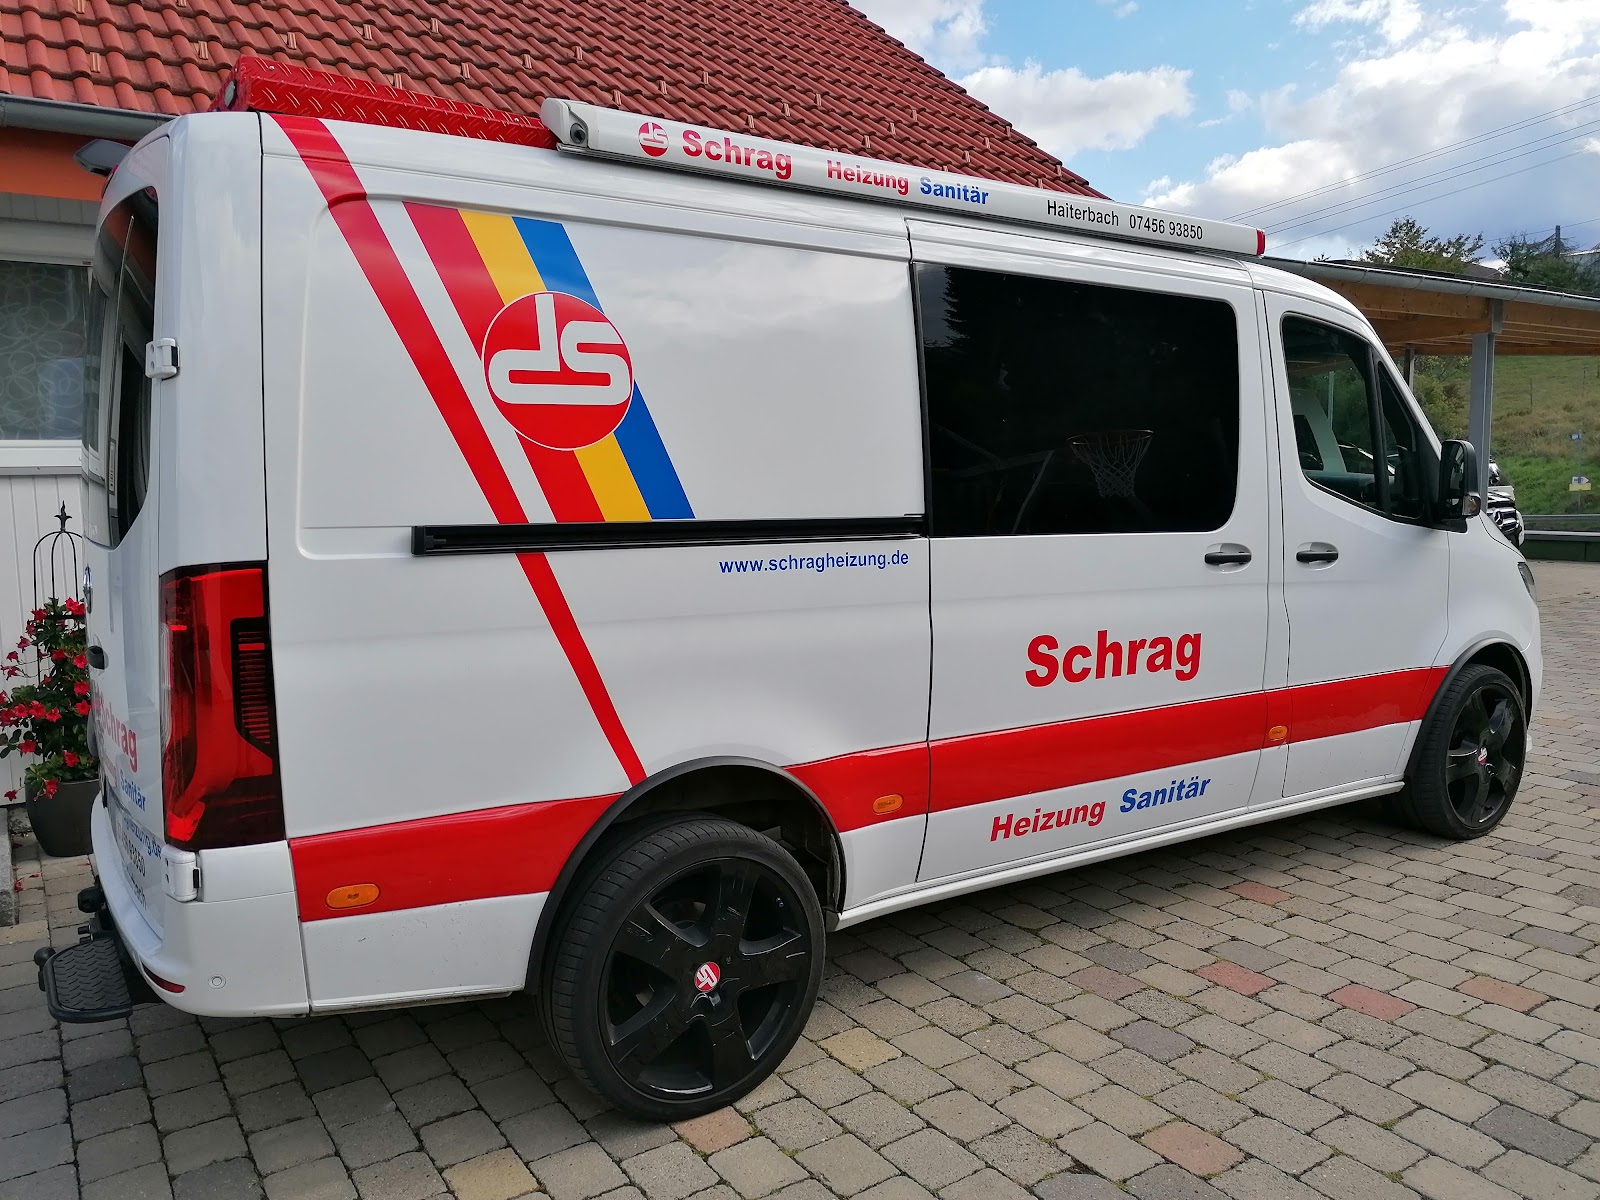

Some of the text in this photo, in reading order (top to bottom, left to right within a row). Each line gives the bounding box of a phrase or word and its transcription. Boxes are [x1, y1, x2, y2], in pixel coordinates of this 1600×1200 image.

[682, 129, 792, 180] Schrag
[826, 159, 909, 196] Heizung
[919, 176, 989, 205] Sanitär
[1046, 199, 1119, 227] Haiterbach
[1129, 214, 1165, 234] 07456
[1168, 221, 1203, 240] 93850
[719, 549, 909, 575] www.schragheizung.de
[1025, 629, 1202, 688] Schrag
[989, 776, 1211, 843] Heizung Sanitär
